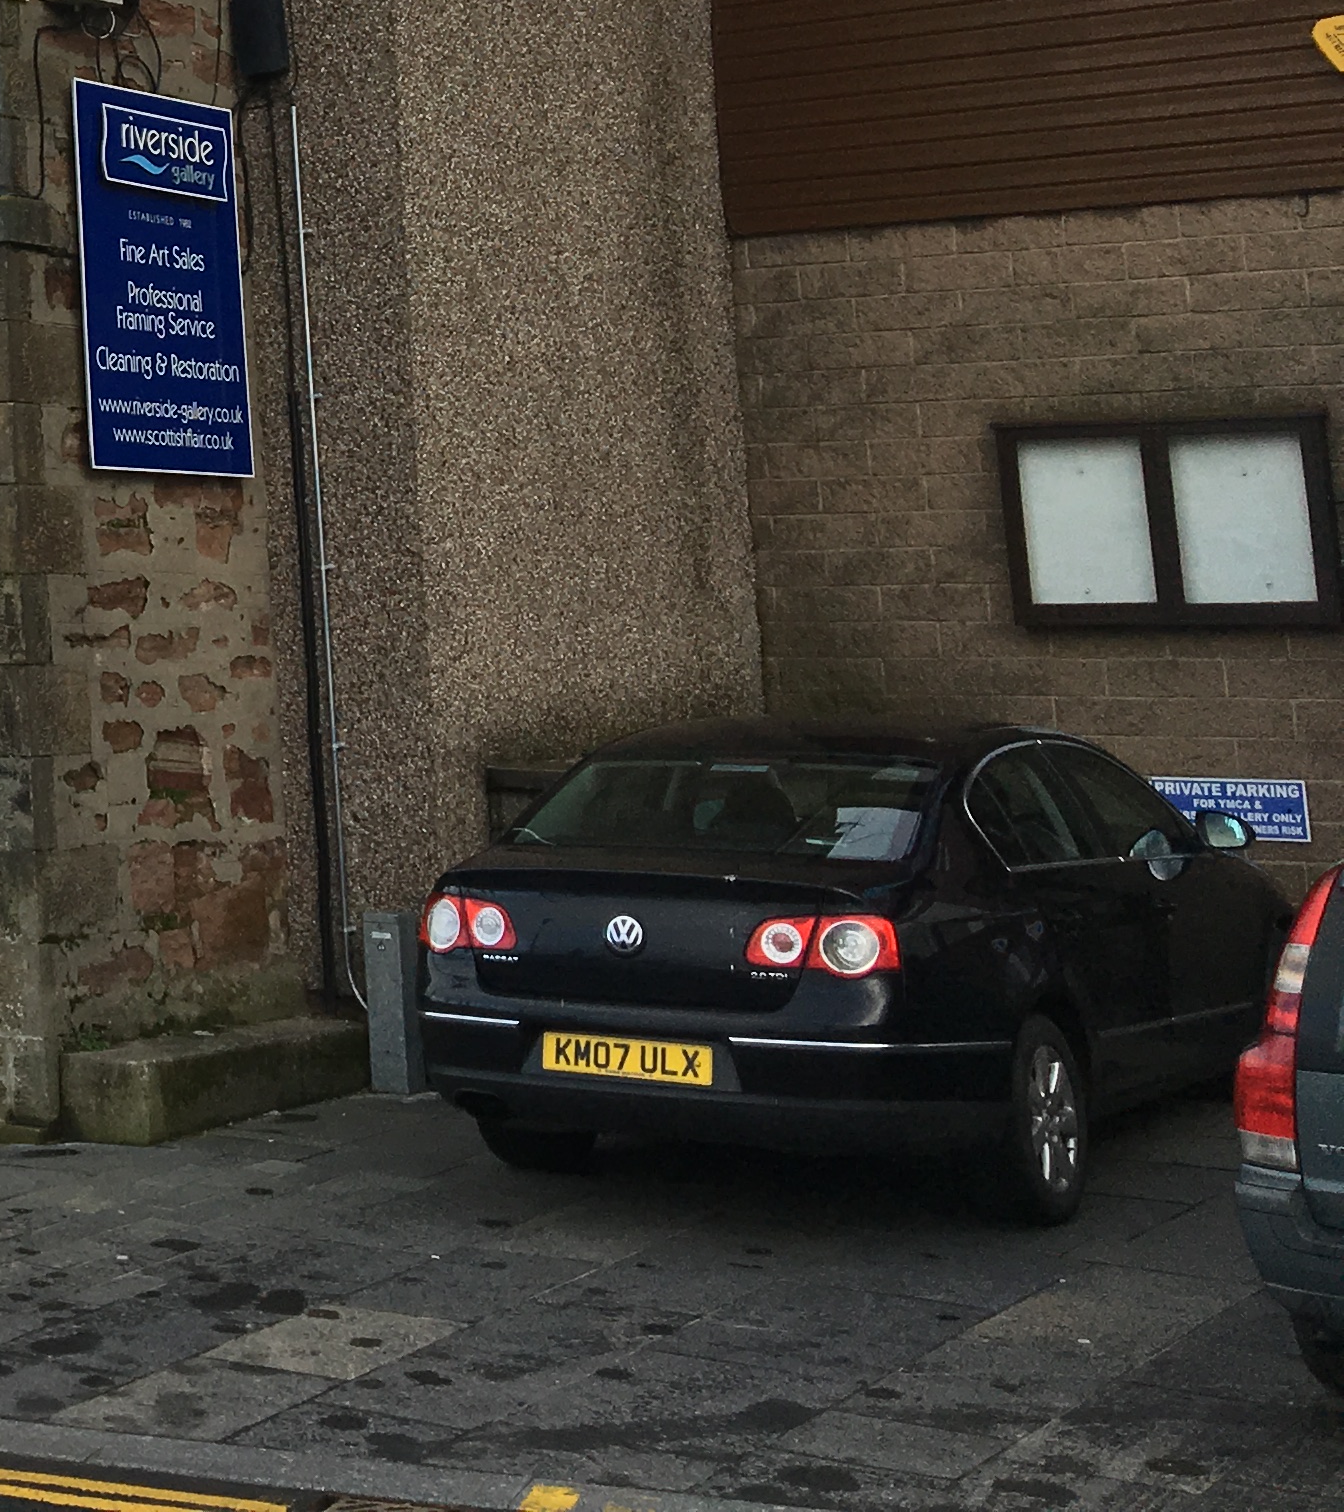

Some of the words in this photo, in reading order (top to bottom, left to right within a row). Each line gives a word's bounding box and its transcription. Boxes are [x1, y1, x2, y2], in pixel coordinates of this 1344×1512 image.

[121, 116, 214, 165] riverside
[171, 164, 214, 190] gallery
[128, 209, 175, 226] ESTABLISHED
[119, 238, 146, 264] Fine
[149, 243, 170, 268] Art
[173, 246, 205, 271] Sales
[128, 281, 203, 312] Professional
[116, 306, 166, 339] Framing
[168, 312, 215, 339] Service
[96, 346, 153, 380] Cleaning
[156, 352, 168, 375] &
[170, 353, 240, 382] Restoration
[98, 396, 244, 425] www.riverside-gallery.co.uk
[113, 427, 234, 450] www.scottishflair.co.uk
[1154, 781, 1222, 797] PRIVATE
[1226, 783, 1300, 799] PARKING
[1193, 798, 1217, 809] FOR
[1219, 799, 1251, 810] YMCA
[1254, 800, 1263, 810] &
[1272, 813, 1303, 824] ONLY
[1281, 825, 1304, 836] RISK
[554, 1037, 631, 1070] KM07
[640, 1045, 699, 1078] ULX
